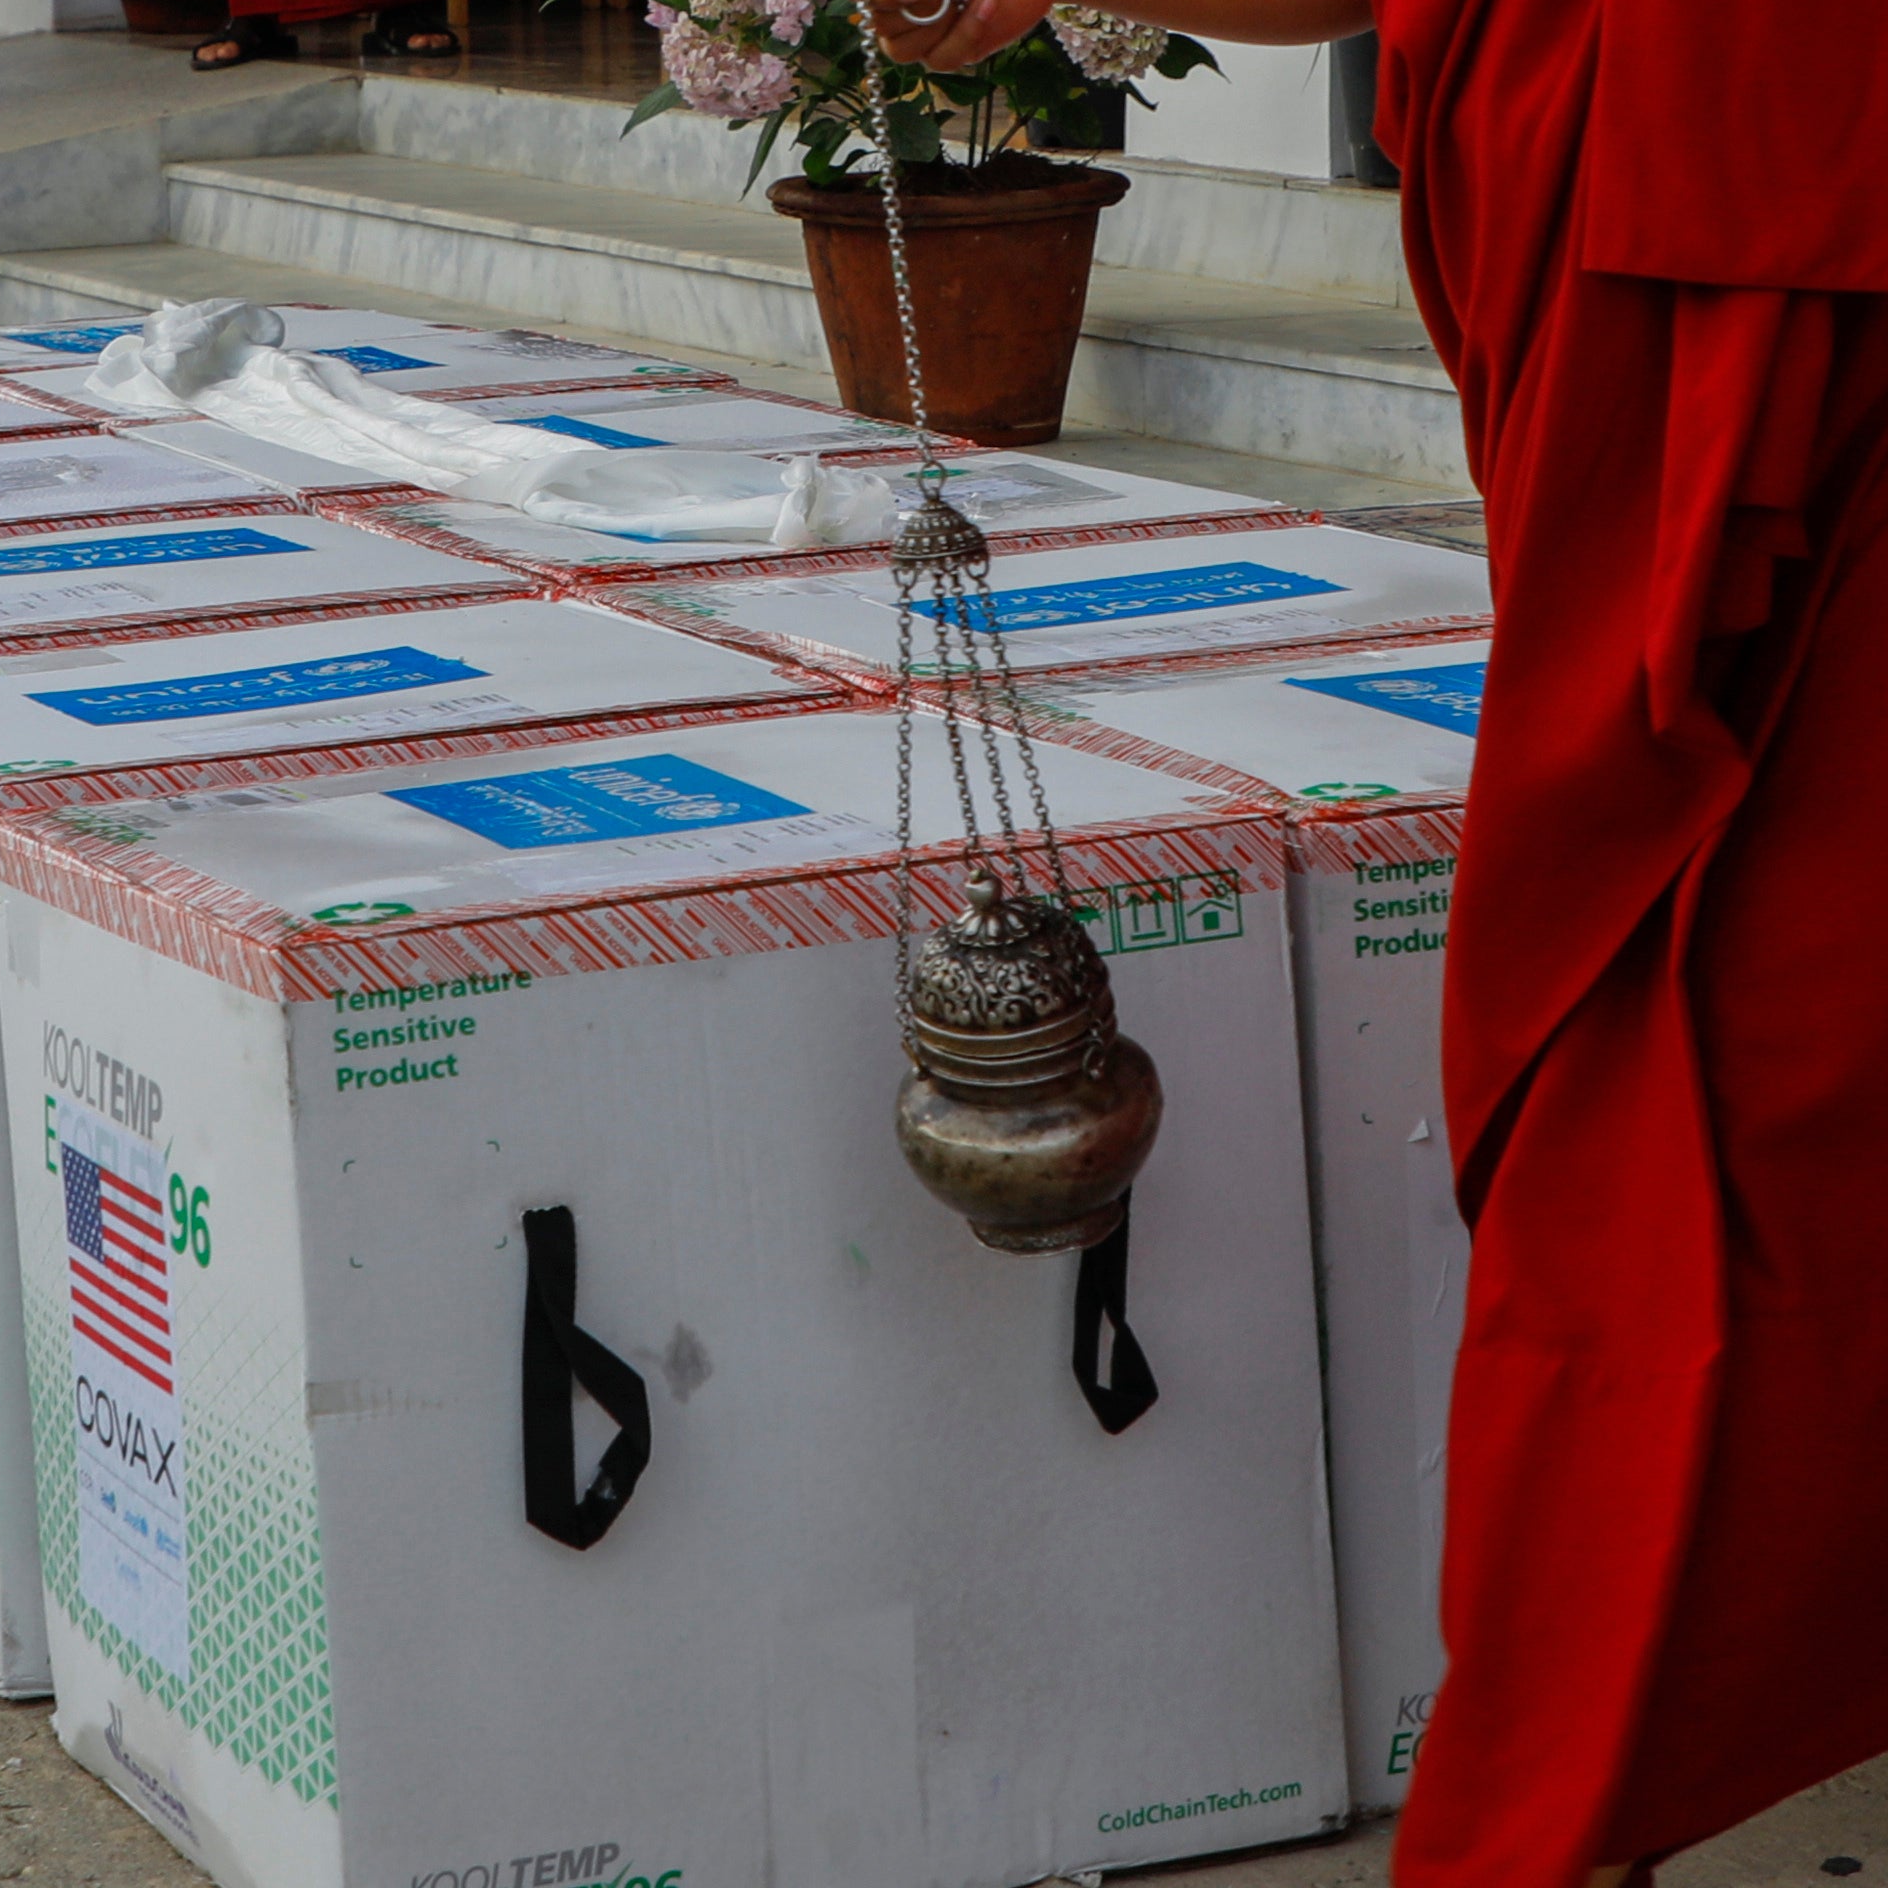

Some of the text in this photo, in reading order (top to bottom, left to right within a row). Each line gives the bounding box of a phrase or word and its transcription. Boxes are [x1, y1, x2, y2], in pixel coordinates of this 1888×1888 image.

[1086, 581, 1292, 616] unicef
[77, 671, 294, 706] unicef
[568, 767, 717, 807] unicef
[1353, 888, 1452, 923] Sensiti
[329, 970, 533, 1013] Temperature
[332, 1015, 477, 1053] Sensitive
[43, 1019, 163, 1142] KOOLTEMP
[336, 1054, 459, 1092] Product
[76, 1374, 177, 1498] COVAX
[1097, 1780, 1303, 1834] ColdChainTech.com
